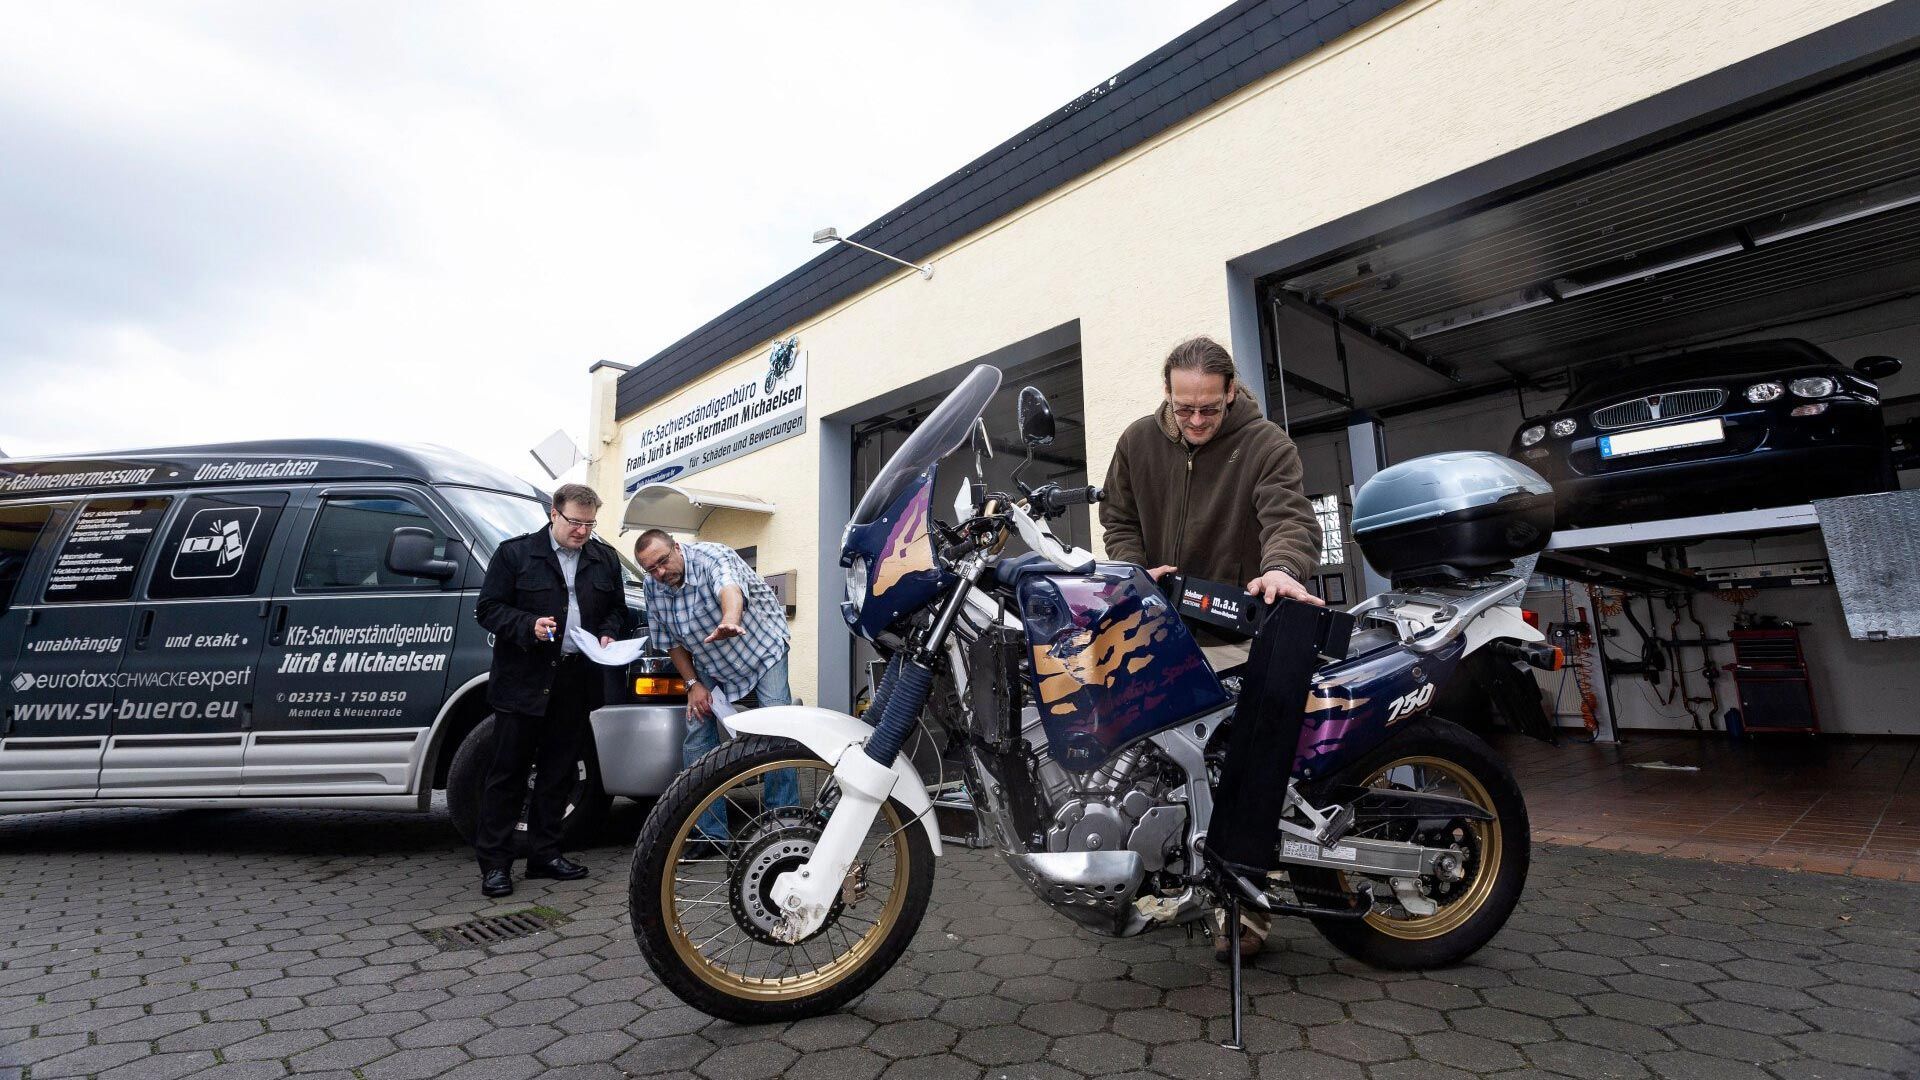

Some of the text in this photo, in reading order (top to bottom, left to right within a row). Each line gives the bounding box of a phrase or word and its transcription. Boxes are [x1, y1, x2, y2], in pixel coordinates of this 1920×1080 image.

[641, 382, 756, 449] Kfz-Sachverständigenbüro
[626, 385, 802, 473] Frank Jürß & Hans-Hermann Michaelsen
[689, 415, 803, 469] für Schäden und Bewertungen
[0, 460, 318, 491] r-Rahmenvermessung Unfallgutachten
[1212, 597, 1239, 613] m.a.x.
[34, 632, 240, 653] unabhängig und exakt
[286, 623, 453, 647] Kfz-Sachverständigenbüro
[278, 651, 446, 674] Jürß & Michaelsen
[36, 666, 251, 691] eurotaxSCHWACKEexpert
[351, 691, 376, 703] 750
[380, 691, 407, 702] 850
[1387, 682, 1435, 723] 750
[13, 699, 239, 721] www.sv-buero.eu
[288, 707, 402, 718] Menden & Neuenrade
